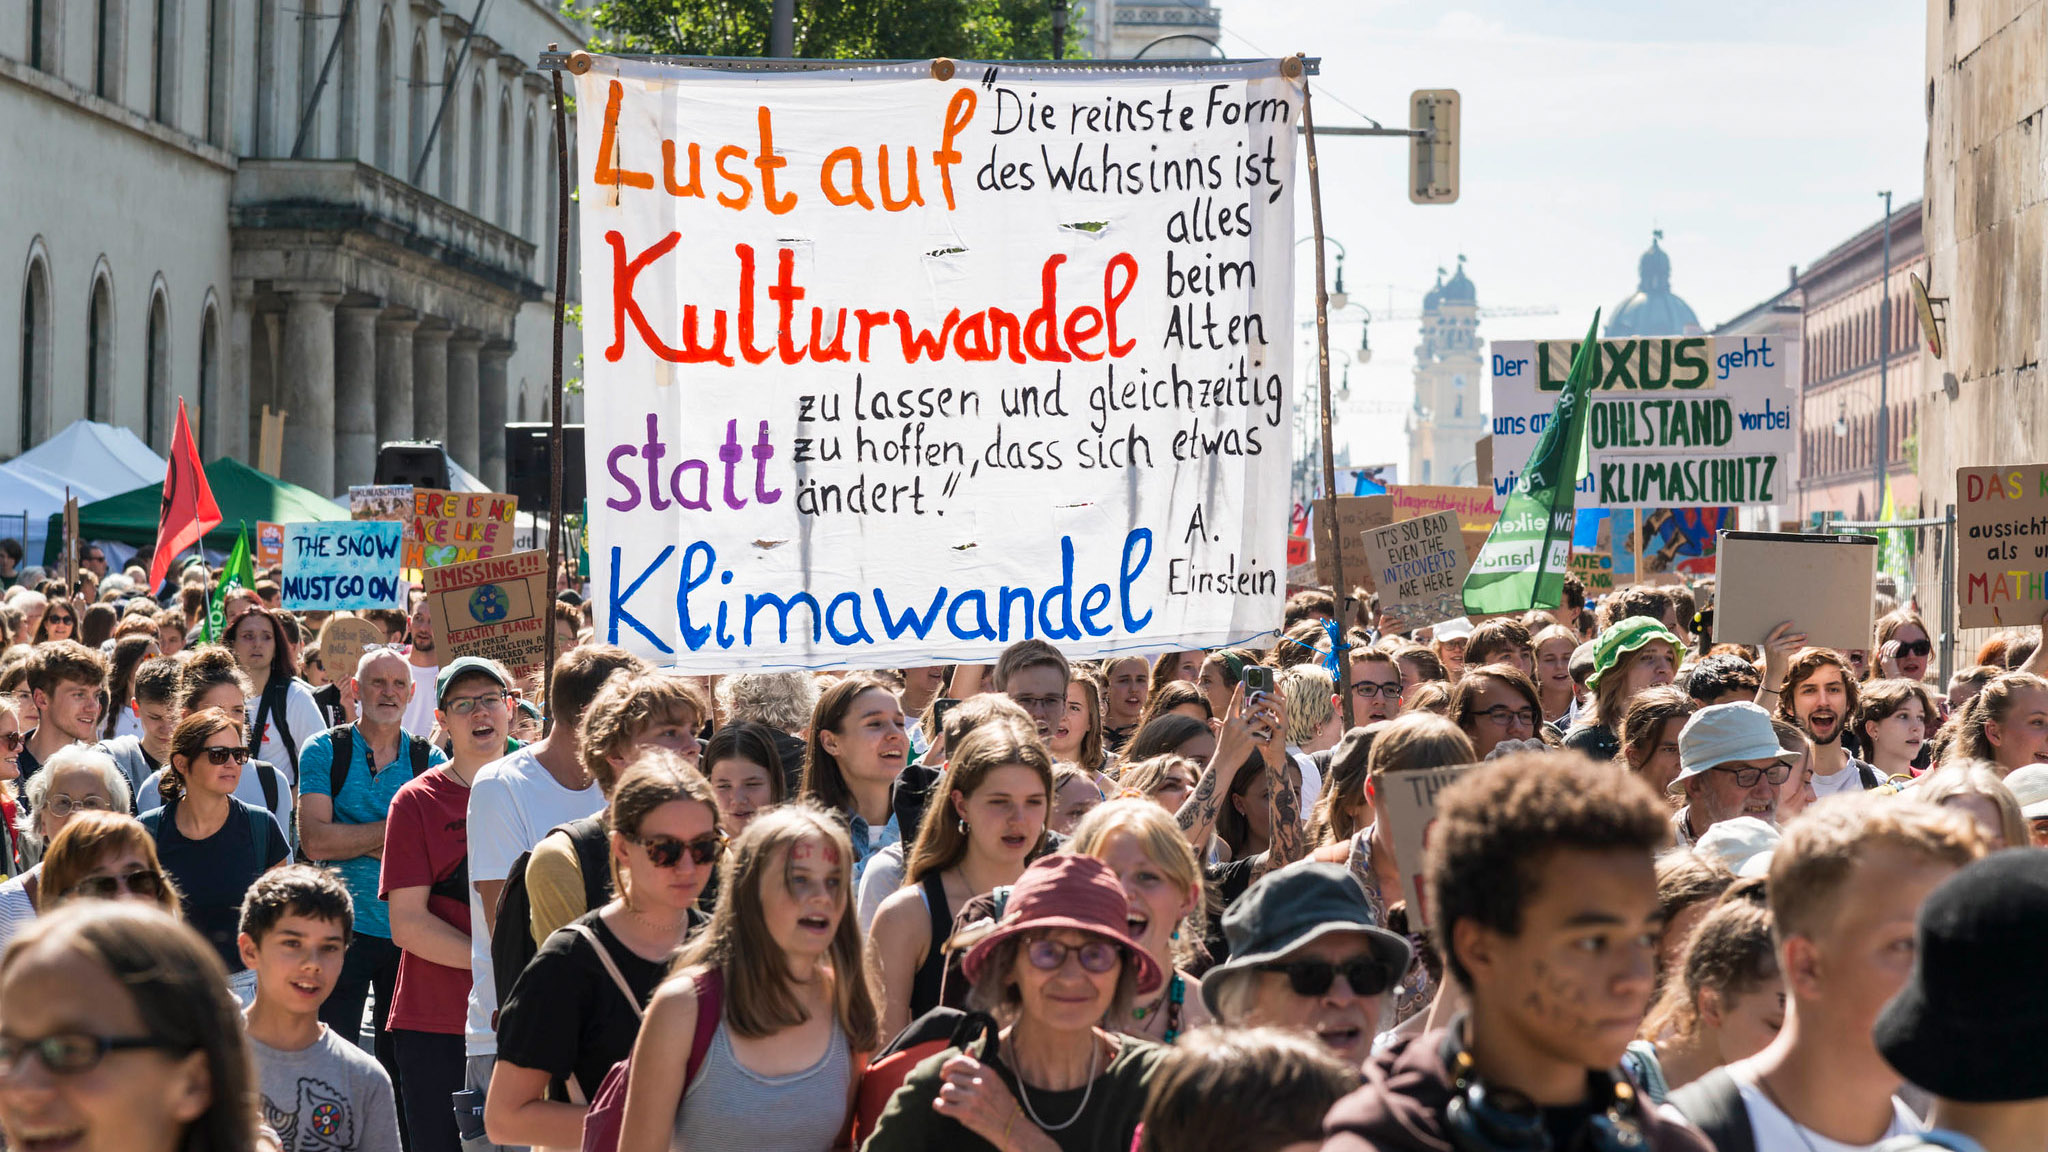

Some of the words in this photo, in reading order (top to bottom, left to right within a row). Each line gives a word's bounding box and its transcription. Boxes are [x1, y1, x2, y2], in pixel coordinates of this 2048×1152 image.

[1071, 89, 1194, 135] reinste
[1206, 84, 1290, 128] Form
[594, 79, 798, 215] Lust
[820, 87, 977, 212] auf
[977, 144, 1036, 191] des
[1041, 142, 1223, 195] Wahsinns
[1236, 136, 1283, 204] ist,
[1167, 196, 1251, 244] alles
[1167, 251, 1255, 298] beim
[604, 230, 1139, 367] Kulturwandel
[1164, 302, 1269, 350] Alten
[1492, 354, 1528, 376] Der
[1717, 337, 1774, 379] geht
[798, 394, 839, 423] zu
[855, 372, 979, 420] lassen
[1000, 369, 1069, 417] und
[1089, 355, 1282, 433] gleichzeitig
[1493, 416, 1525, 435] uns
[1591, 398, 1732, 449] OHLSTAND
[1738, 398, 1790, 430] vorbei
[606, 413, 783, 512] statt
[794, 436, 840, 462] zu
[856, 422, 979, 478] hoffen,
[984, 422, 1063, 469] dass
[1077, 423, 1153, 468] sich
[1172, 418, 1262, 461] etwas
[1601, 456, 1777, 503] KLIMASCHUTZ
[1967, 471, 2023, 502] DAS
[415, 493, 459, 519] ERE
[466, 496, 484, 517] IS
[488, 499, 515, 523] NO
[1184, 503, 1220, 543] A.
[292, 535, 331, 557] THE
[336, 534, 399, 559] SNOW
[414, 517, 448, 543] ACE
[454, 521, 499, 543] LIKE
[1375, 528, 1398, 549] IT'S
[1401, 521, 1420, 541] SO
[1423, 515, 1448, 537] BAD
[1388, 543, 1418, 565] EVEN
[1420, 536, 1444, 554] THE
[1988, 540, 2018, 560] als
[1169, 553, 1276, 596] Einstein
[1383, 549, 1457, 584] INTROVERTS
[1399, 579, 1420, 599] ARE
[1423, 570, 1454, 593] HERE
[283, 576, 336, 601] MUST
[335, 575, 364, 599] GO
[368, 576, 399, 602] ON
[607, 528, 1152, 654] Klimawandel
[447, 625, 495, 644] HEALTHY
[502, 618, 543, 634] PLANET
[482, 635, 509, 646] FOREST
[525, 645, 543, 654] SPEC
